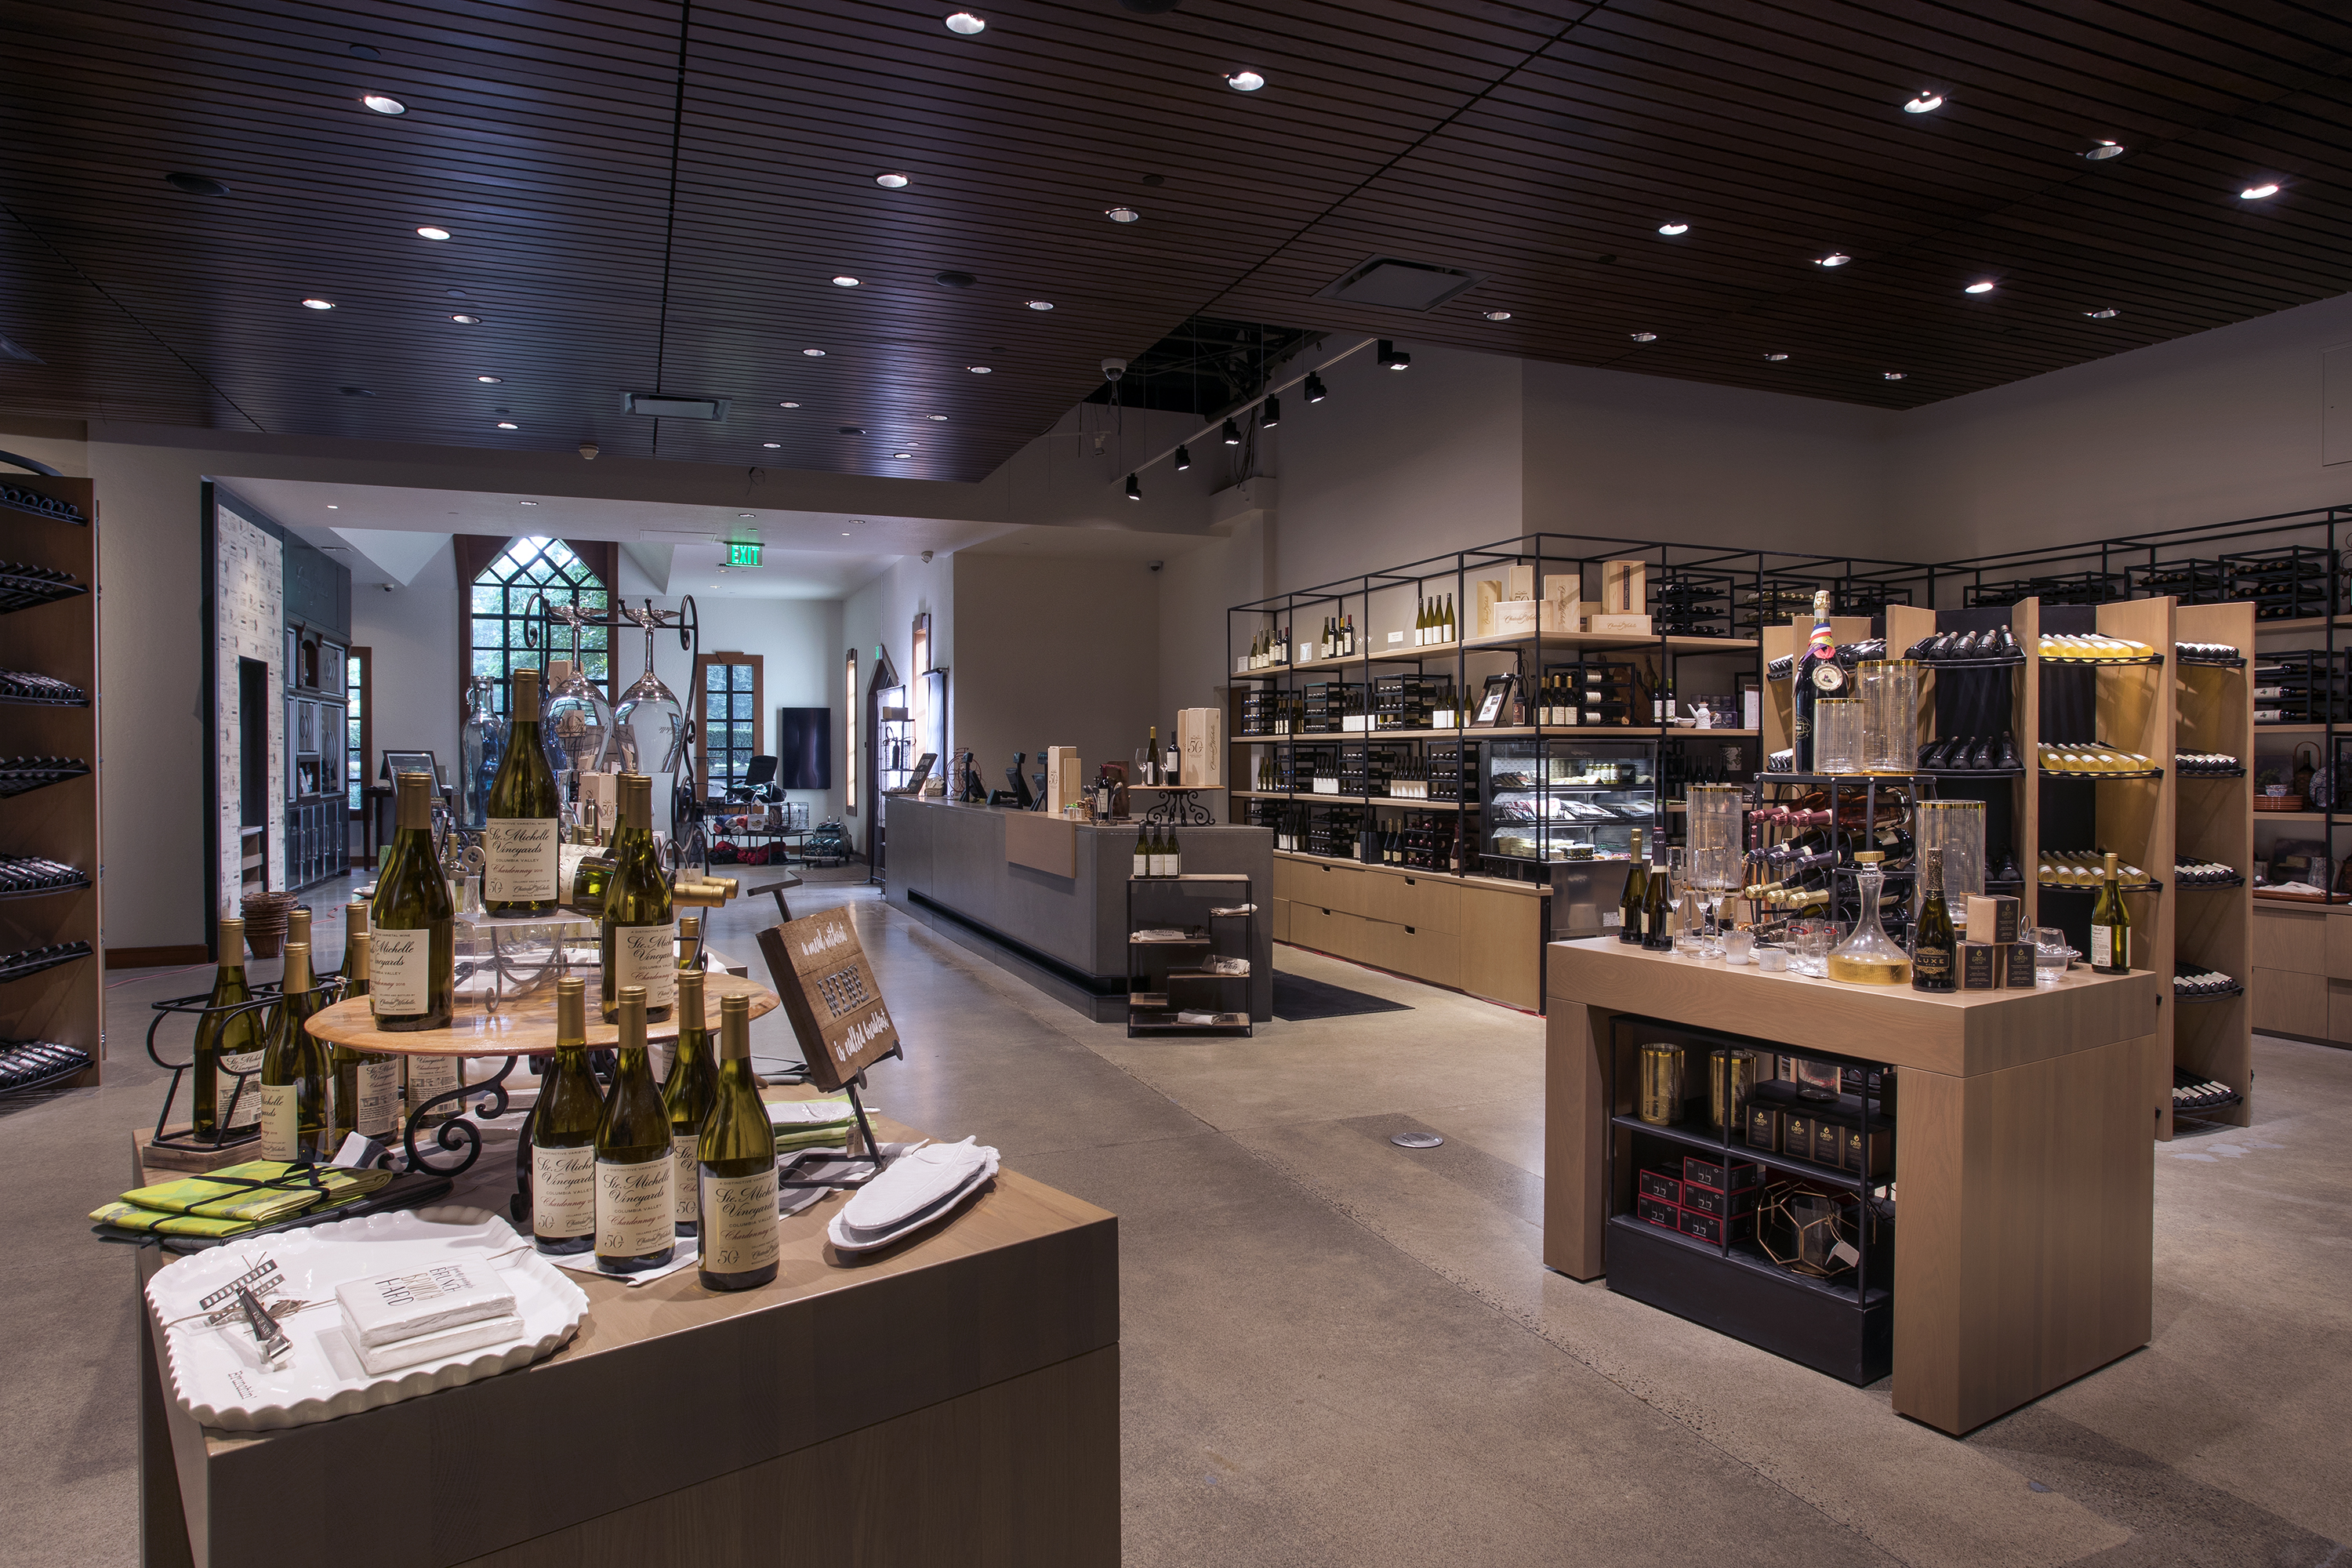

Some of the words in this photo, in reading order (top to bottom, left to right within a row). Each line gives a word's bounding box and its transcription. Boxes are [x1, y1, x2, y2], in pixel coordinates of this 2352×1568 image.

[731, 545, 760, 564] EXIT
[1188, 740, 1203, 753] 50
[489, 827, 503, 840] Ste.
[503, 829, 550, 843] Michelle
[492, 840, 543, 858] Vineyards
[491, 864, 533, 877] Chardonnay
[488, 880, 503, 894] 50
[627, 935, 647, 949] Ste.
[801, 942, 809, 956] a
[808, 928, 826, 955] meal
[823, 922, 848, 949] without
[376, 940, 415, 955] Michelle
[630, 971, 670, 982] Chardonnay
[816, 964, 869, 1018] WINE
[833, 1040, 846, 1062] is
[844, 1023, 866, 1057] called
[862, 1008, 889, 1040] breakfast
[674, 1145, 694, 1160] Ste.
[537, 1156, 553, 1172] Ste.
[604, 1174, 622, 1189] Ste.
[623, 1167, 670, 1190] Michelle
[540, 1196, 586, 1210] Chardonnay
[608, 1185, 664, 1207] Vineyards
[716, 1188, 737, 1203] Ste.
[677, 1201, 697, 1214] 50
[722, 1197, 775, 1220] Vineyards
[539, 1215, 555, 1229] 50
[607, 1214, 656, 1228] Chardonnay
[758, 1215, 774, 1224] VALLEY
[604, 1234, 625, 1249] 50
[720, 1229, 768, 1241] Chardonnay
[717, 1250, 739, 1265] 50
[401, 1272, 445, 1301] BRUNCH
[430, 1267, 463, 1293] BRUNCH
[375, 1277, 414, 1306] HARD
[228, 1370, 257, 1399] Brunchin'
